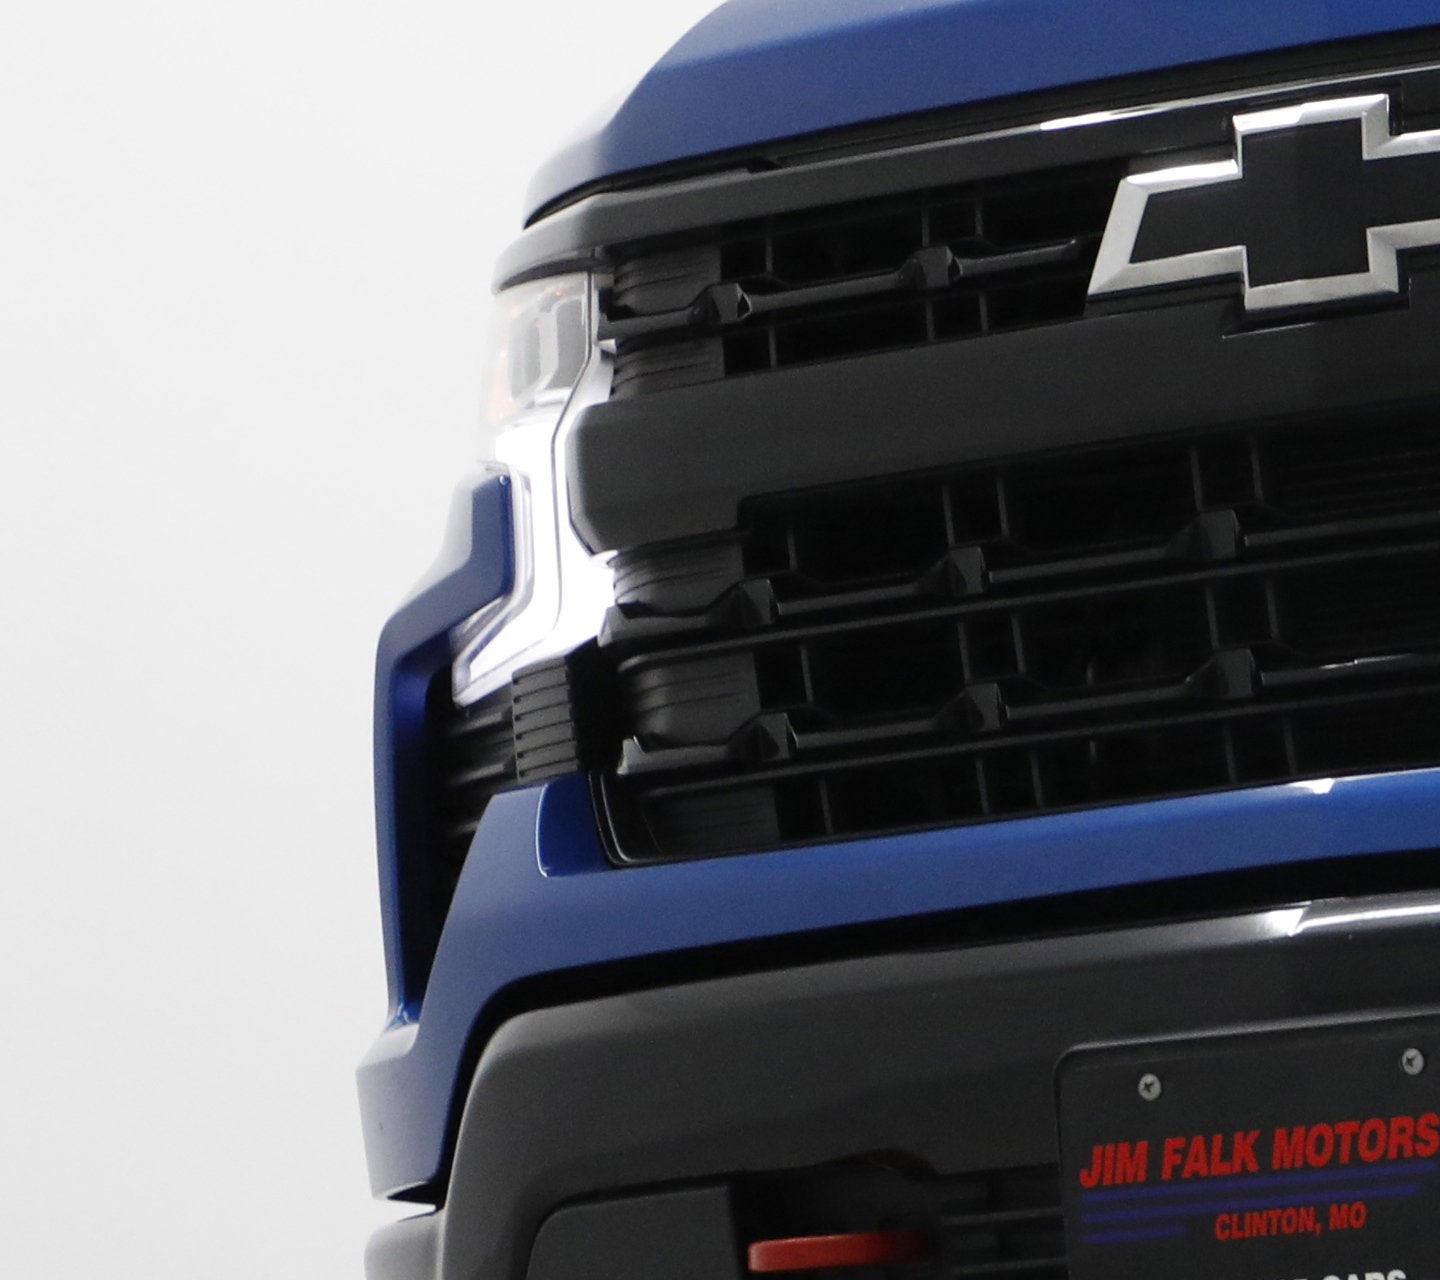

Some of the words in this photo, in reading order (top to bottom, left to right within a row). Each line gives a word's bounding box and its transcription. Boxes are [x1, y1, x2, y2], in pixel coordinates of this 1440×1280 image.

[1080, 1139, 1148, 1188] JIM
[1161, 1130, 1261, 1181] FALK
[1272, 1112, 1440, 1170] MOTORS
[1214, 1206, 1323, 1241] CLINTON,
[1329, 1201, 1368, 1231] MO
